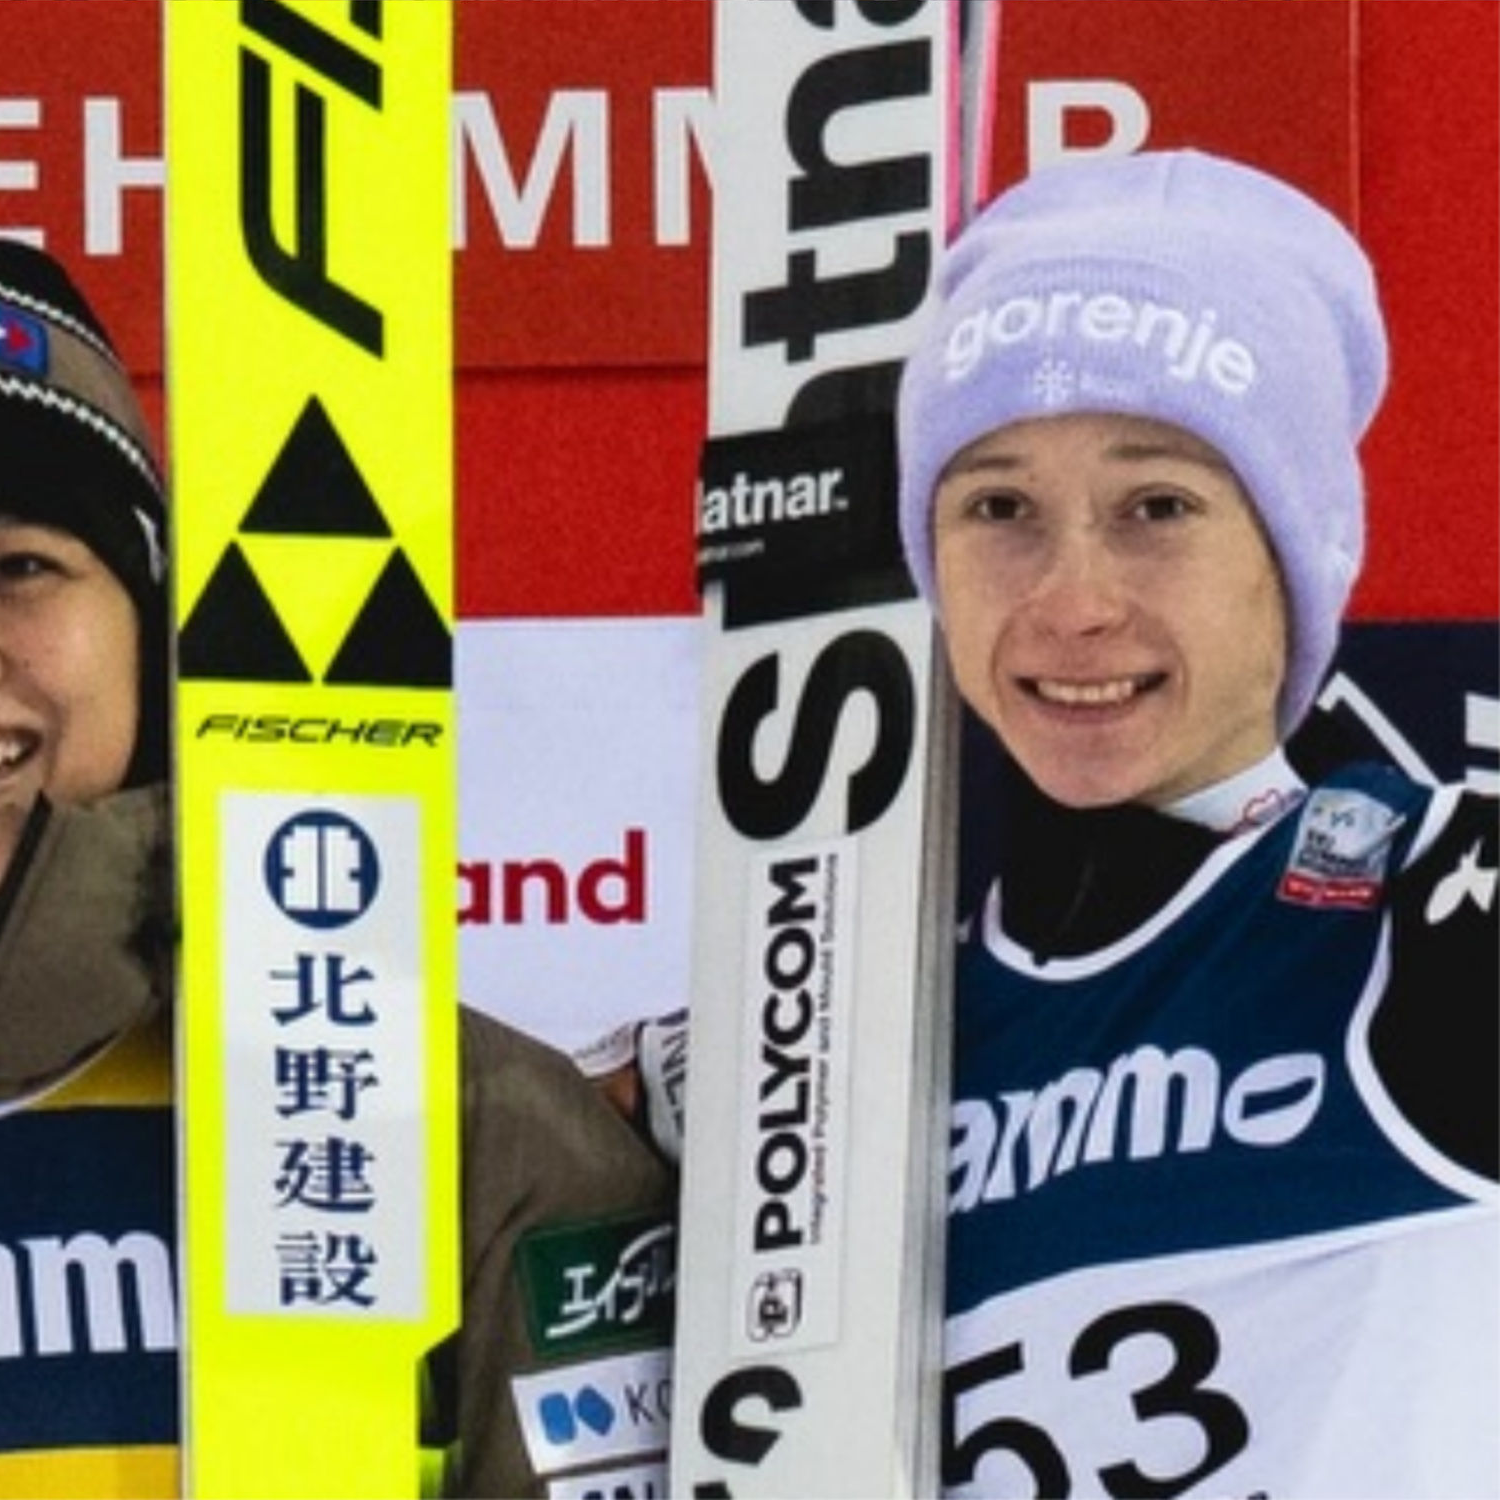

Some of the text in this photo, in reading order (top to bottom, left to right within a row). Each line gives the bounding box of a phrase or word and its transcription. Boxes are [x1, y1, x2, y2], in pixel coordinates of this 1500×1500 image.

[945, 290, 1257, 394] gorenje
[196, 713, 444, 749] FISCHER
[268, 951, 380, 1308] 北野建設
[753, 856, 819, 1253] POLYCOM
[946, 1044, 1327, 1217] ammo
[941, 1301, 1251, 1500] 53
